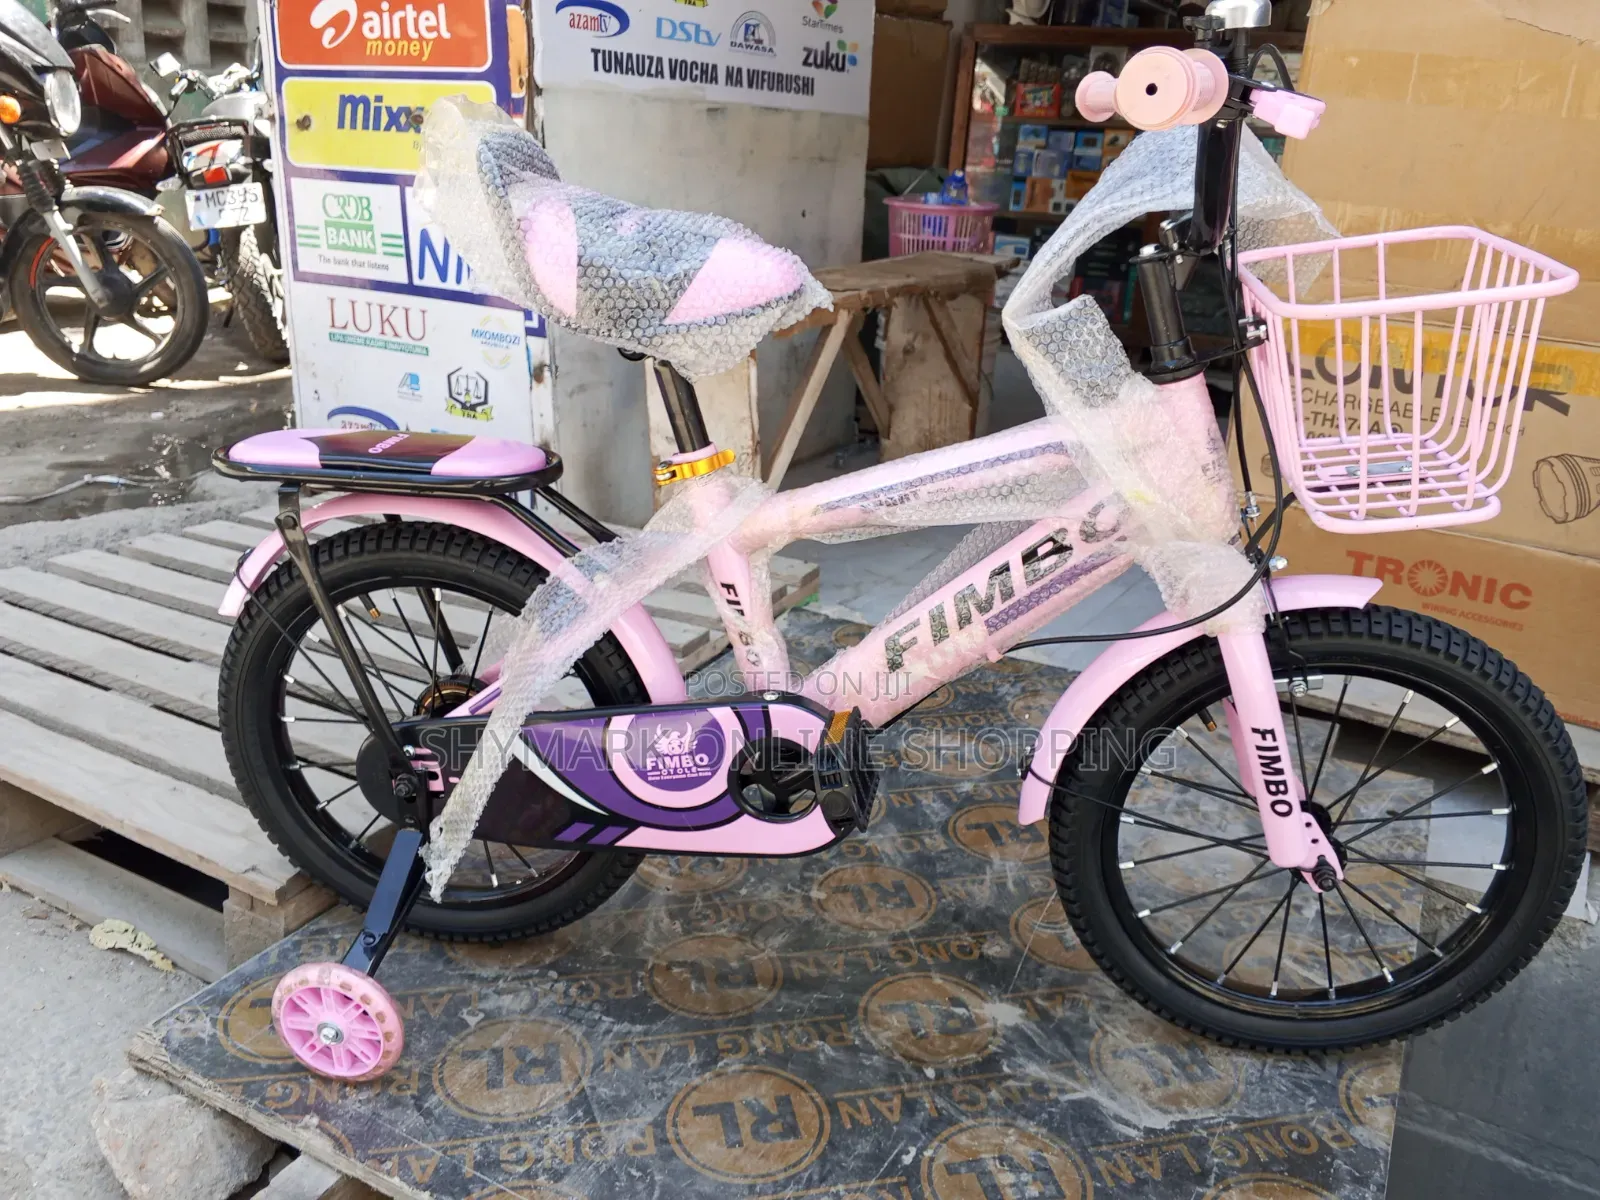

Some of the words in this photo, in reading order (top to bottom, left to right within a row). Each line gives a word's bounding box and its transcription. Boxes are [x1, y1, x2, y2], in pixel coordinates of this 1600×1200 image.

[362, 1, 451, 40] airtel
[801, 16, 844, 34] StarTimes
[366, 39, 433, 61] money
[730, 41, 775, 54] DAWASA
[802, 41, 847, 73] zuku
[591, 48, 664, 80] TUNAUZA
[668, 57, 719, 86] VOCHA
[725, 66, 743, 88] NA
[747, 68, 815, 97] VIFURUSHI
[327, 227, 375, 249] BANK
[318, 254, 331, 264] The
[333, 256, 349, 267] bank
[351, 259, 365, 269] that
[367, 260, 390, 271] listens
[327, 297, 428, 341] LUKU
[471, 327, 520, 345] MKOMBOZI
[1290, 384, 1441, 424] CHARGEABLE
[1346, 550, 1533, 610] TRONIC
[646, 753, 709, 772] FIMBO
[1251, 726, 1293, 818] FIMBO
[889, 938, 988, 967] ONG
[693, 1094, 800, 1148] RL
[1208, 1114, 1356, 1167] RONG
[1095, 1143, 1200, 1187] LAN
